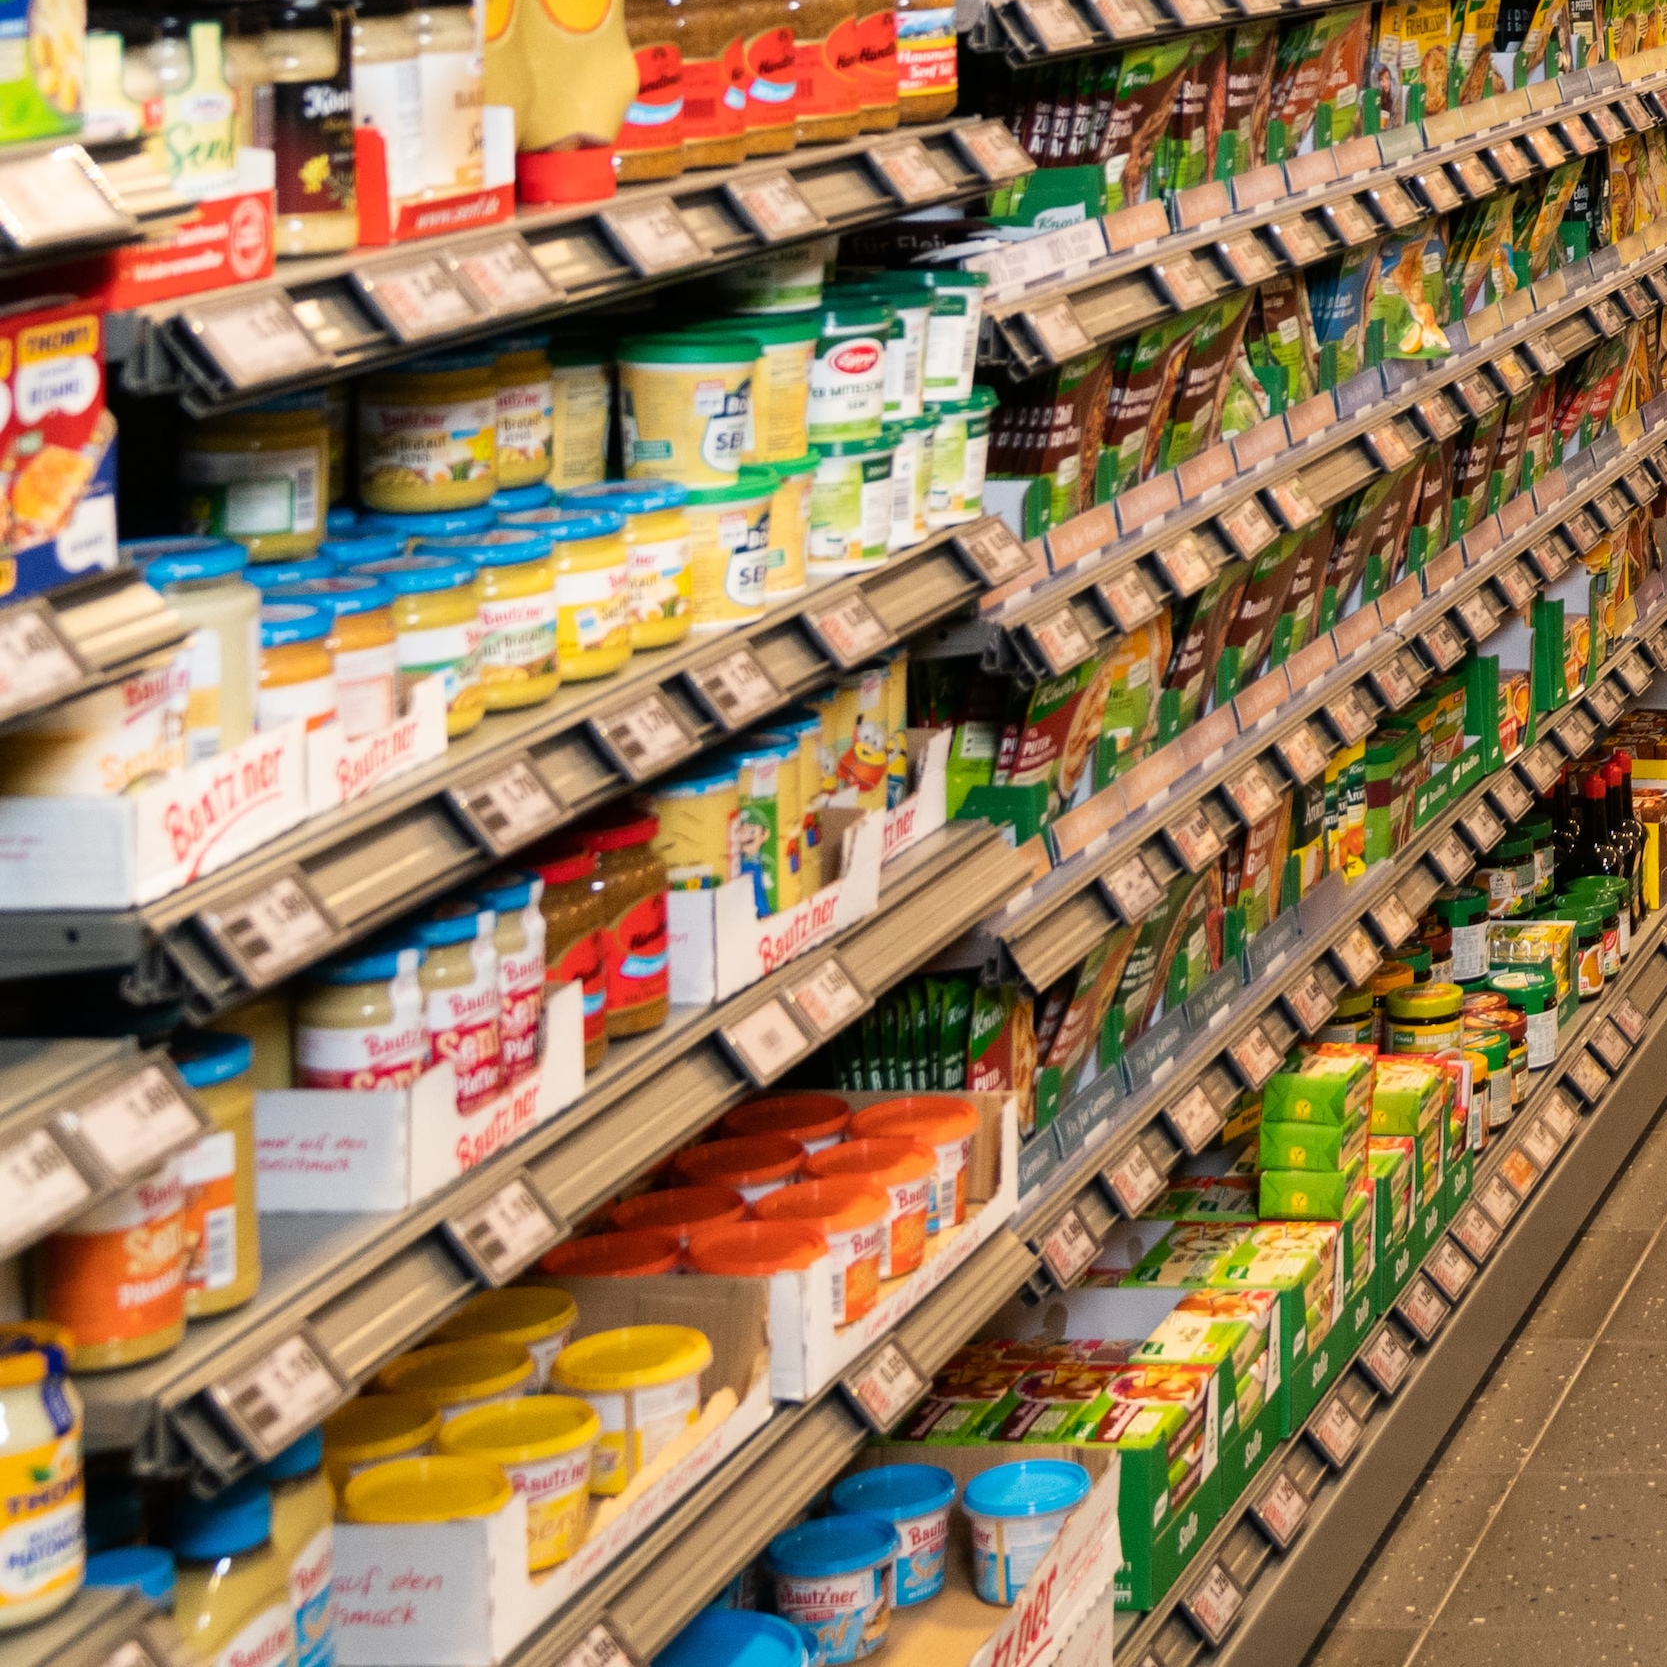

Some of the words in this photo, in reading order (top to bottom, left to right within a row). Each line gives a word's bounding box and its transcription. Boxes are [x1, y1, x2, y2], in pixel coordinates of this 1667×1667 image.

[166, 120, 236, 174] Senf
[759, 897, 838, 977] Bautz'ner
[457, 1085, 537, 1172] Bautz'ner
[1472, 1204, 1483, 1224] 1.29
[1445, 1248, 1459, 1267] 1.29
[1420, 1288, 1433, 1309] 1.29
[1381, 1339, 1395, 1359] 1.29
[1331, 1406, 1347, 1427] 1.29
[1277, 1483, 1292, 1505] 1.29
[781, 1589, 857, 1606] Bautz'ner
